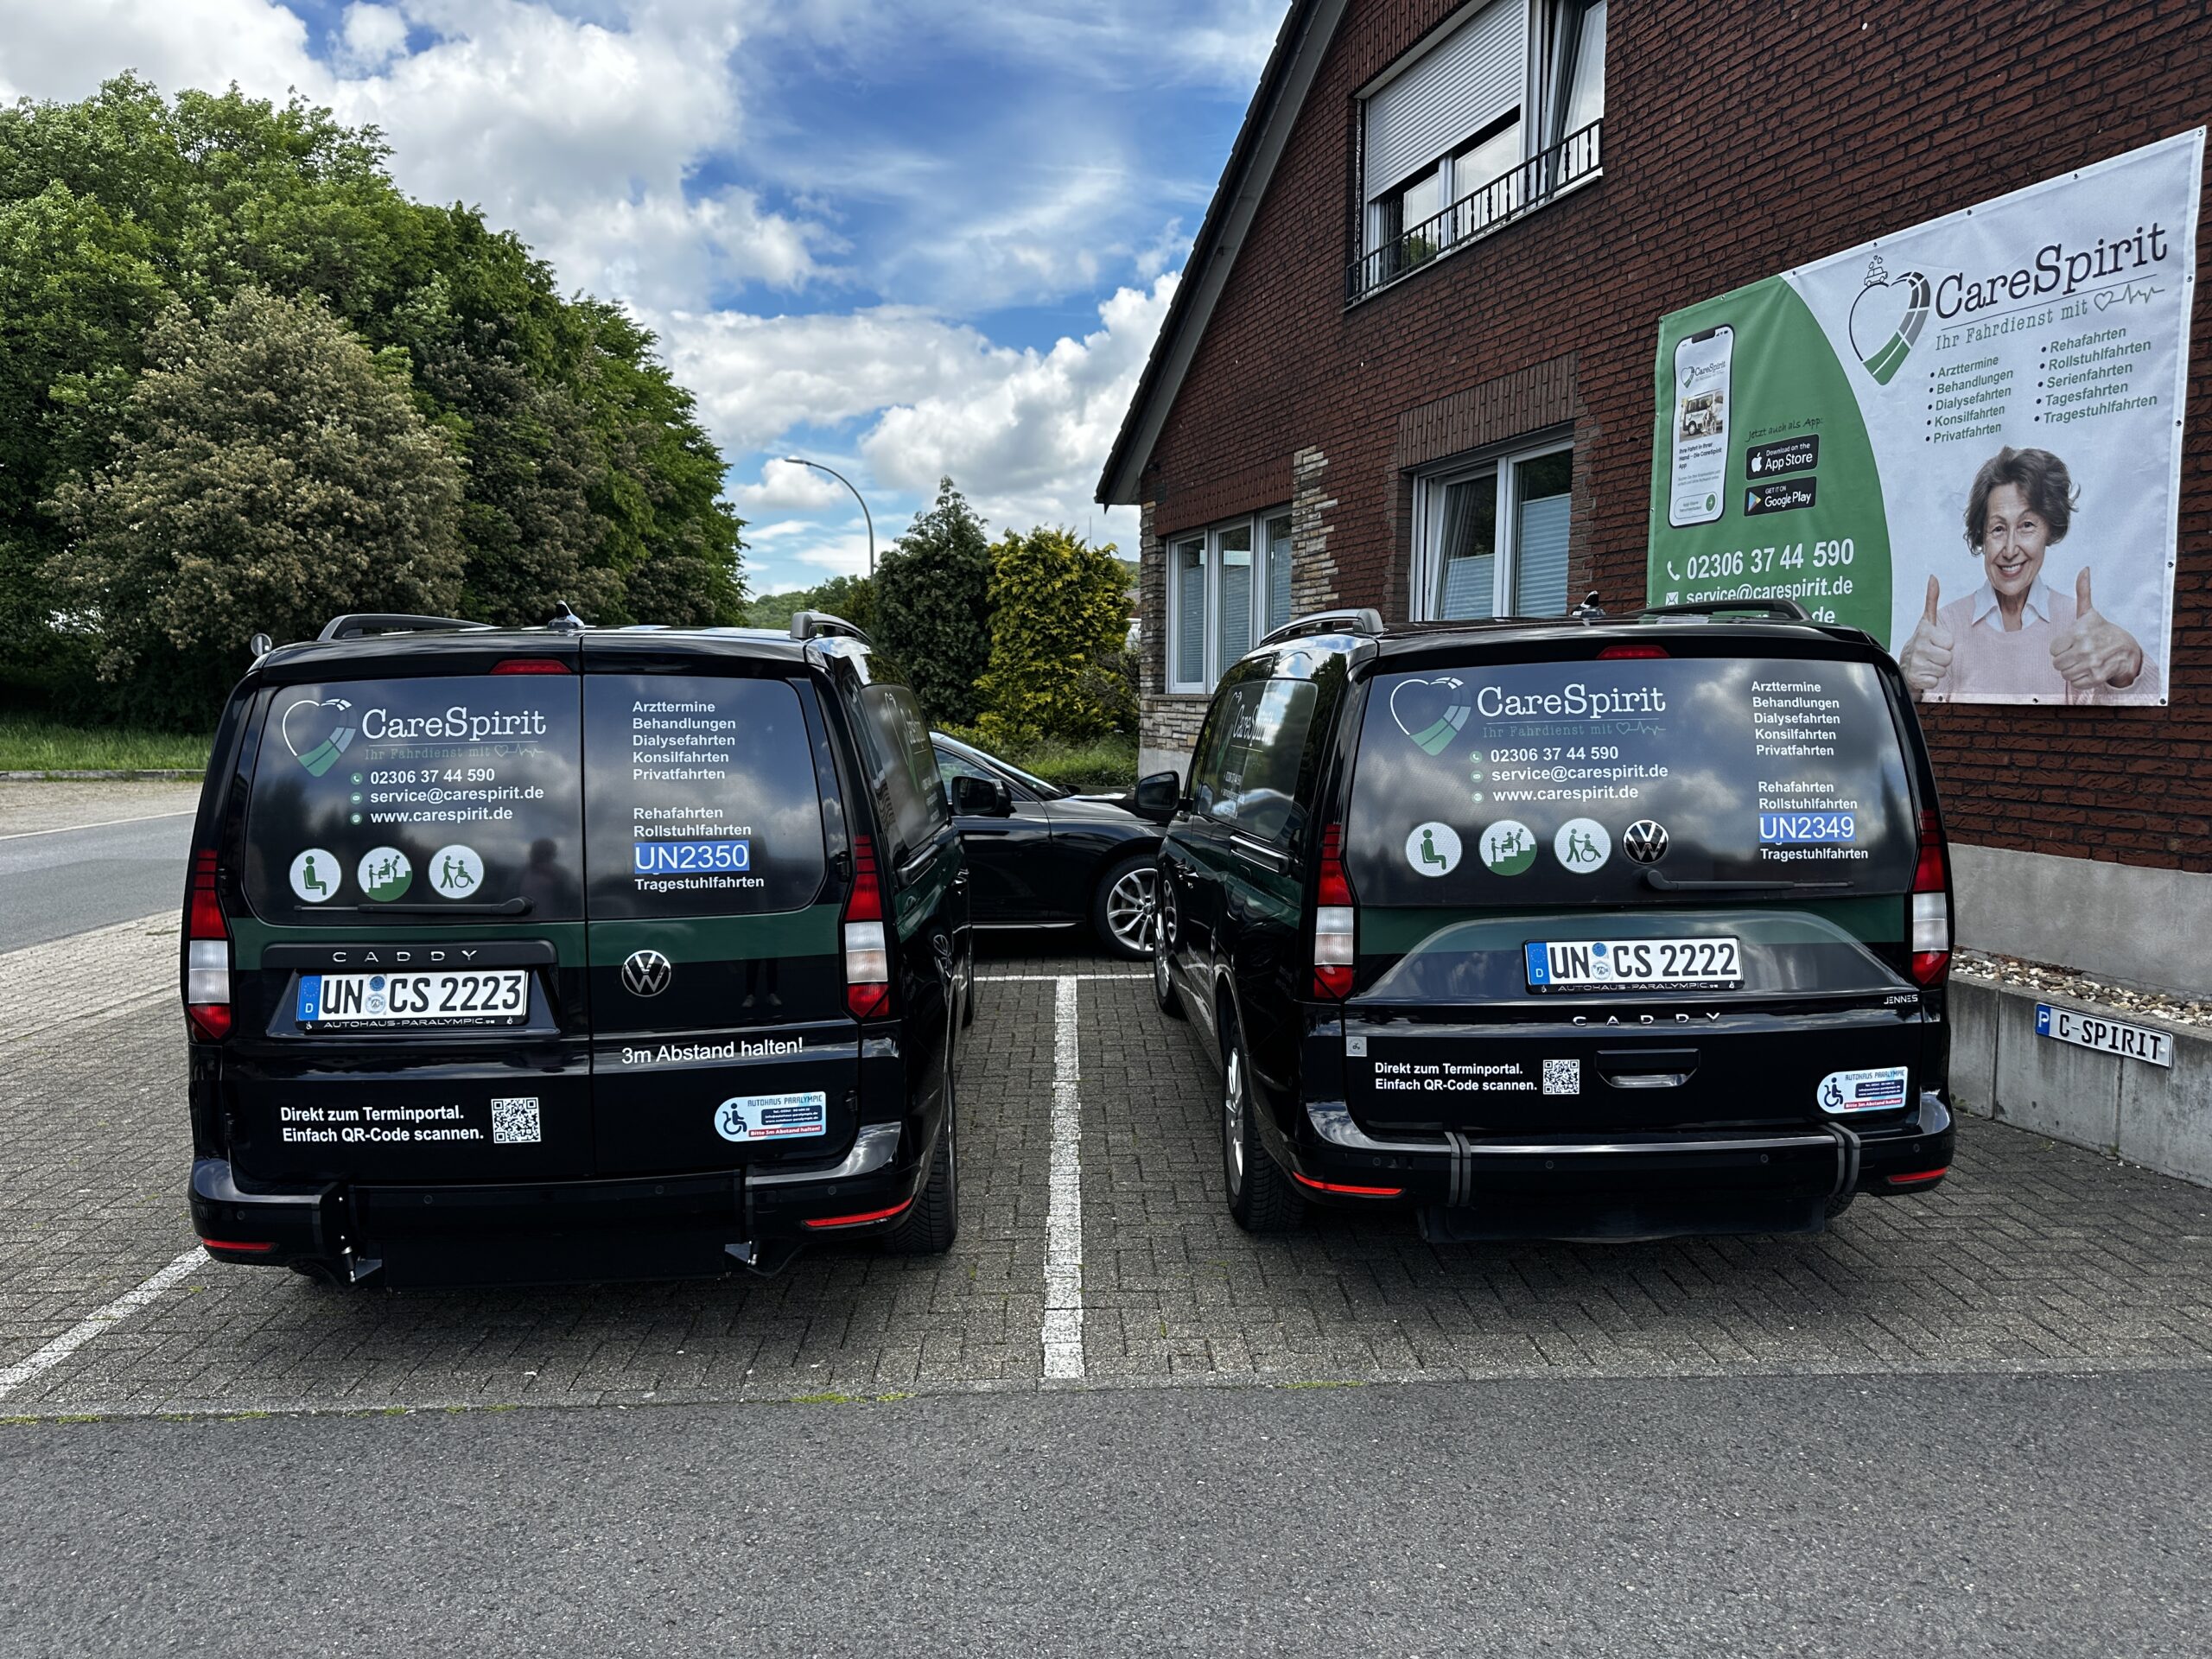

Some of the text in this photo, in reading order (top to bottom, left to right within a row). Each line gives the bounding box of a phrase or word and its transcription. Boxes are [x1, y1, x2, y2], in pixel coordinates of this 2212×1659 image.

[1935, 222, 2168, 320] CareSpirit
[1936, 298, 2088, 351] Ihr Fahrdienst mit
[2050, 327, 2126, 354] Rehafahrten
[2048, 340, 2152, 372] Rollstuhlfahrten
[1694, 360, 1726, 377] CareSpirit
[1937, 355, 1999, 378] Arzttermine
[1936, 368, 2013, 395] Behandlungen
[2046, 362, 2133, 390] Serienfahrten
[1936, 385, 2012, 412] Dialysefahrten
[2045, 382, 2128, 408] Tagesfahrten
[1934, 404, 2005, 428] Konsilfahrten
[2044, 395, 2158, 425] Tragestuhlfahrten
[1745, 428, 1767, 442] Jetzt
[1769, 423, 1787, 435] auch
[1788, 419, 1801, 429] als
[1933, 422, 2002, 443] Privatfahrten
[1765, 445, 1790, 457] Download
[1764, 453, 1813, 472] App Store
[1764, 491, 1812, 508] Google Play
[1687, 538, 1854, 580] 02306 37 44 590
[1686, 575, 1853, 604] service@carespirit.de
[1751, 681, 1821, 692] Arzttermine
[632, 701, 715, 713] Arzttermine
[1477, 683, 1666, 719] CareSpirit
[1752, 696, 1840, 710] Behandlungen
[362, 706, 547, 741] CareSpirit
[632, 717, 736, 731] Behandlungen
[1754, 713, 1840, 725] Dialysefahrten
[1483, 723, 1612, 738] Ihr Fahrdienst mit
[1755, 728, 1836, 741] Konsilfahrten
[632, 734, 735, 748] Dialysefahrten
[365, 746, 490, 761] Ihr Fahrdienst mit
[632, 751, 729, 764] Konsilfahrten
[1491, 746, 1619, 763] 02306 37 44 590
[1756, 744, 1834, 756] Privatfahrten
[370, 768, 495, 785] 02306 37 44 590
[632, 768, 726, 780] Privatfahrten
[1491, 765, 1669, 783] service@carespirit.de
[1493, 785, 1639, 802] www.carespirit.de
[1758, 781, 1834, 792] Rehafahrten
[370, 787, 544, 804] service@carespirit.de
[1758, 798, 1858, 810] Rollstuhlfahrten
[371, 807, 513, 823] www.carespirit.de
[633, 807, 723, 819] Rehafahrten
[633, 824, 752, 837] Rollstuhlfahrten
[1759, 816, 1855, 839] UN2349
[635, 844, 748, 870] UN2350
[1760, 848, 1869, 862] Tragestuhlfahrten
[634, 876, 765, 892] Tragestuhlfahrten
[333, 950, 477, 963] CADDY
[1535, 943, 1738, 979] D UN CS 2222
[305, 976, 522, 1014] D UN CS 2223
[1884, 994, 1918, 1005] JENNES
[1573, 1012, 1719, 1026] CADDY
[2038, 1010, 2050, 1028] P
[621, 1037, 803, 1065] 3m Abstand halten!
[1375, 1062, 1523, 1077] Direkt zum Terminportal.
[1375, 1078, 1537, 1091] Einfach QR-Code scannen.
[747, 1095, 823, 1107] AUTOHAUS PARALYMPIC
[280, 1105, 464, 1123] Direkt zum Terminportal.
[283, 1127, 484, 1143] Einfach QR-Code scannen.
